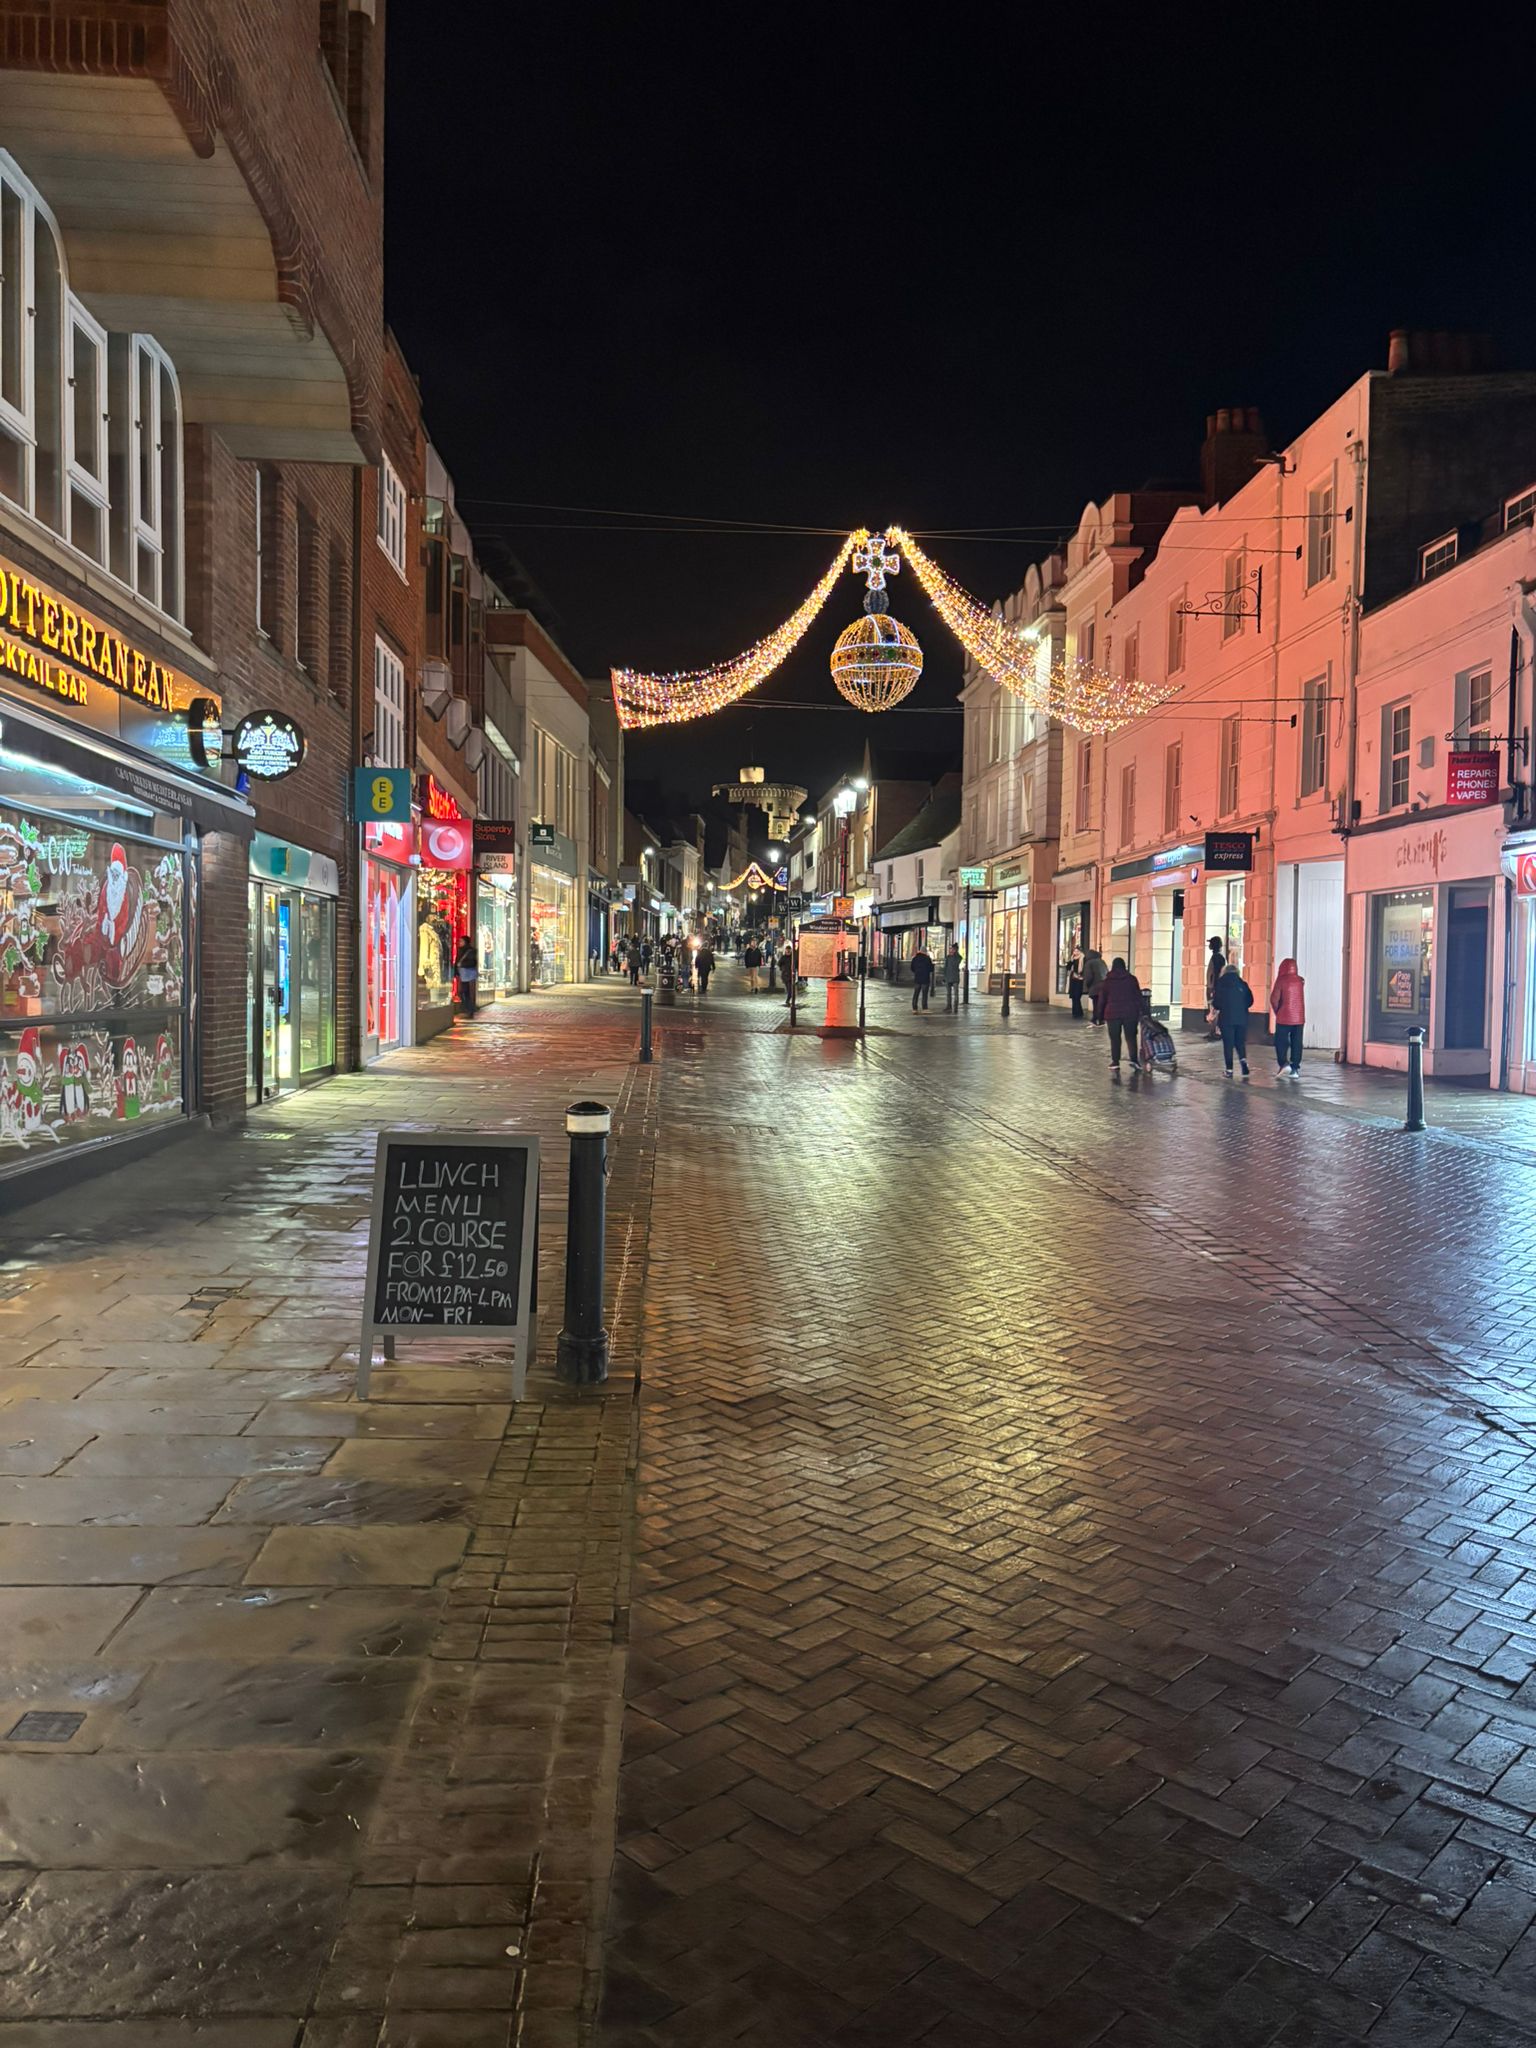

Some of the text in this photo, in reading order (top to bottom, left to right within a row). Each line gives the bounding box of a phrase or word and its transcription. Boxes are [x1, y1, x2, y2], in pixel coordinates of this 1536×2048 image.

[58, 668, 88, 705] BAR
[1457, 769, 1497, 778] REPAIRS
[1456, 780, 1496, 789] PHONES
[1456, 791, 1487, 800] VAPES
[475, 824, 512, 836] Superdry
[486, 855, 506, 863] RIVER
[1214, 853, 1244, 861] express
[1390, 931, 1398, 942] TO
[1385, 944, 1419, 957] FOR SALE
[400, 1160, 499, 1189] LUNCH
[395, 1194, 482, 1216] MENU
[418, 1218, 507, 1249] COURSE
[387, 1250, 509, 1279] FOR £12.50
[386, 1281, 436, 1304] FROM
